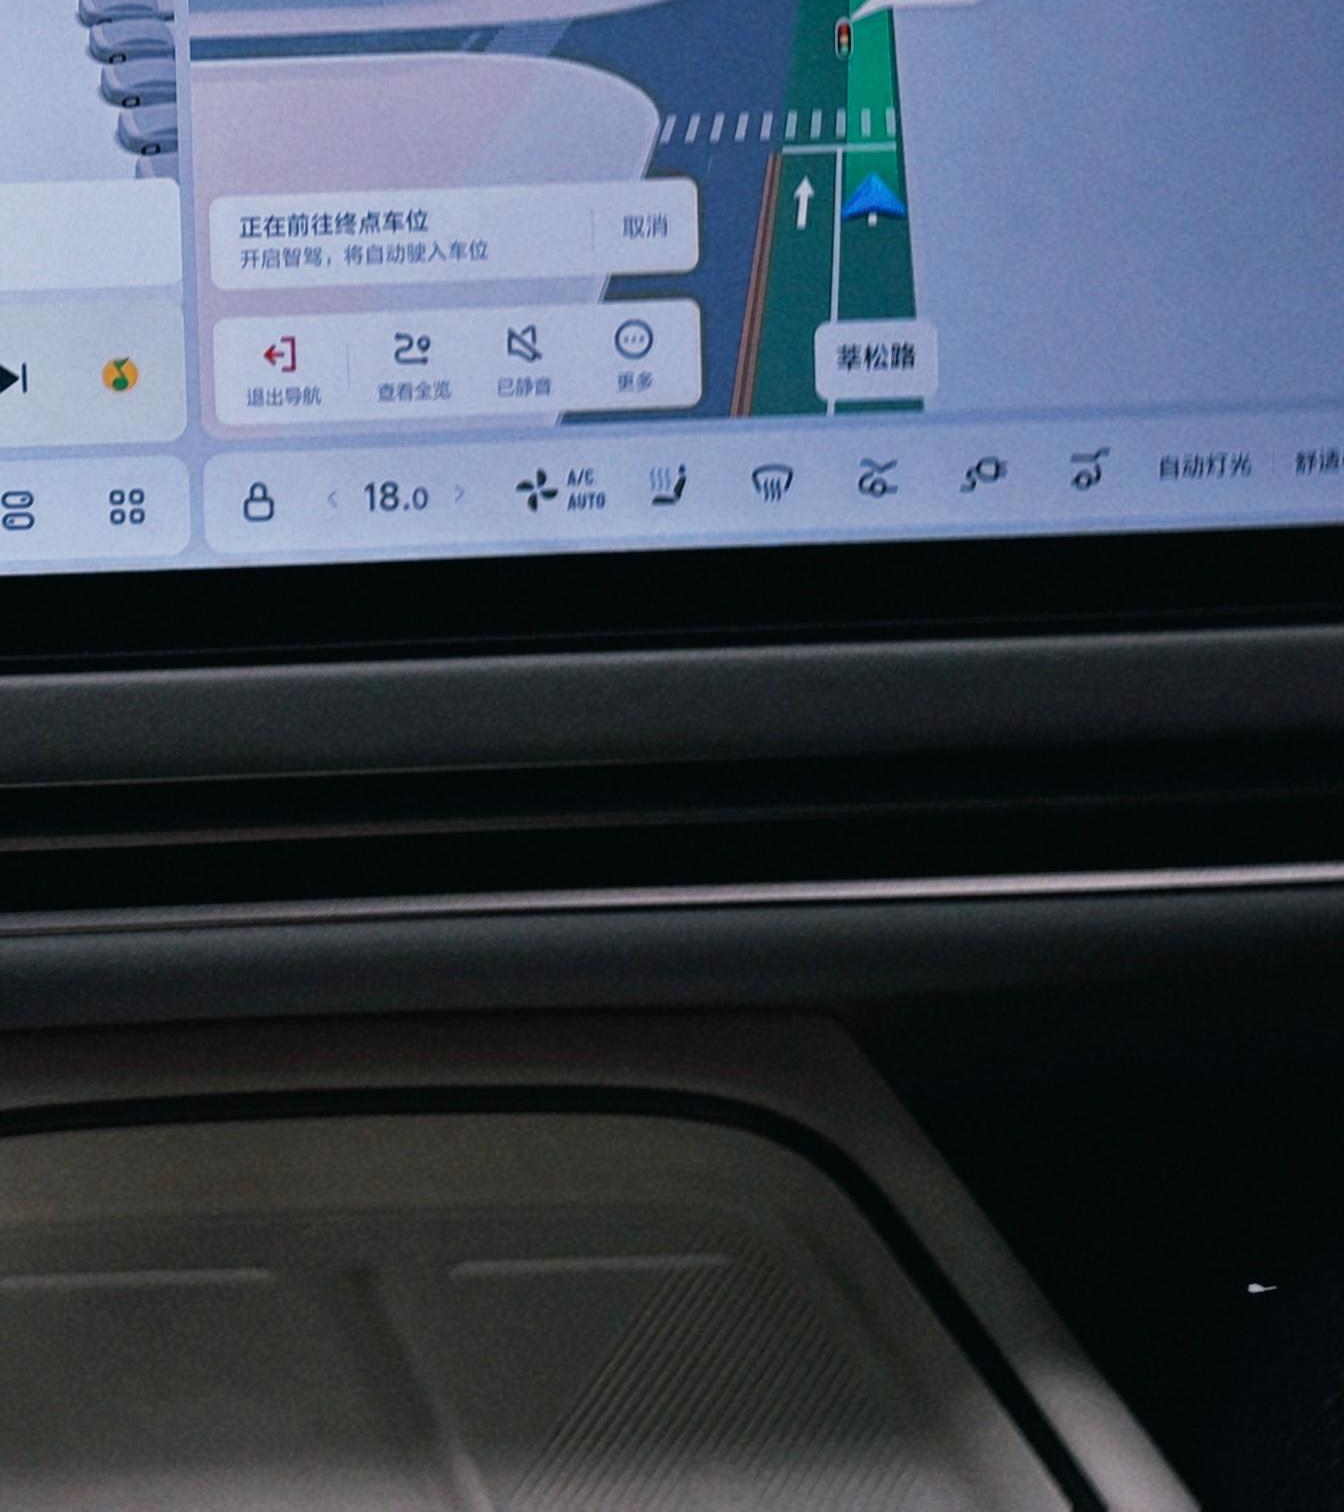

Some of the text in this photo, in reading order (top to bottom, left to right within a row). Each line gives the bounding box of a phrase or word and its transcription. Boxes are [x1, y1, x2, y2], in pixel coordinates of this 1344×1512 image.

[239, 208, 429, 239] 正在前往终点车位
[622, 215, 668, 239] 取消
[240, 240, 489, 270] 开启智驾，将自动驶入车位
[836, 340, 916, 372] 莘松路
[377, 378, 452, 402] 查看全览
[496, 375, 553, 398] 已静音
[617, 370, 654, 393] 更多
[246, 384, 322, 408] 退出导航
[1160, 451, 1252, 481] 自动灯光
[1295, 447, 1344, 476] 舒适
[567, 467, 595, 486] A/C
[363, 481, 429, 512] 18.0
[567, 492, 606, 512] AUTO
